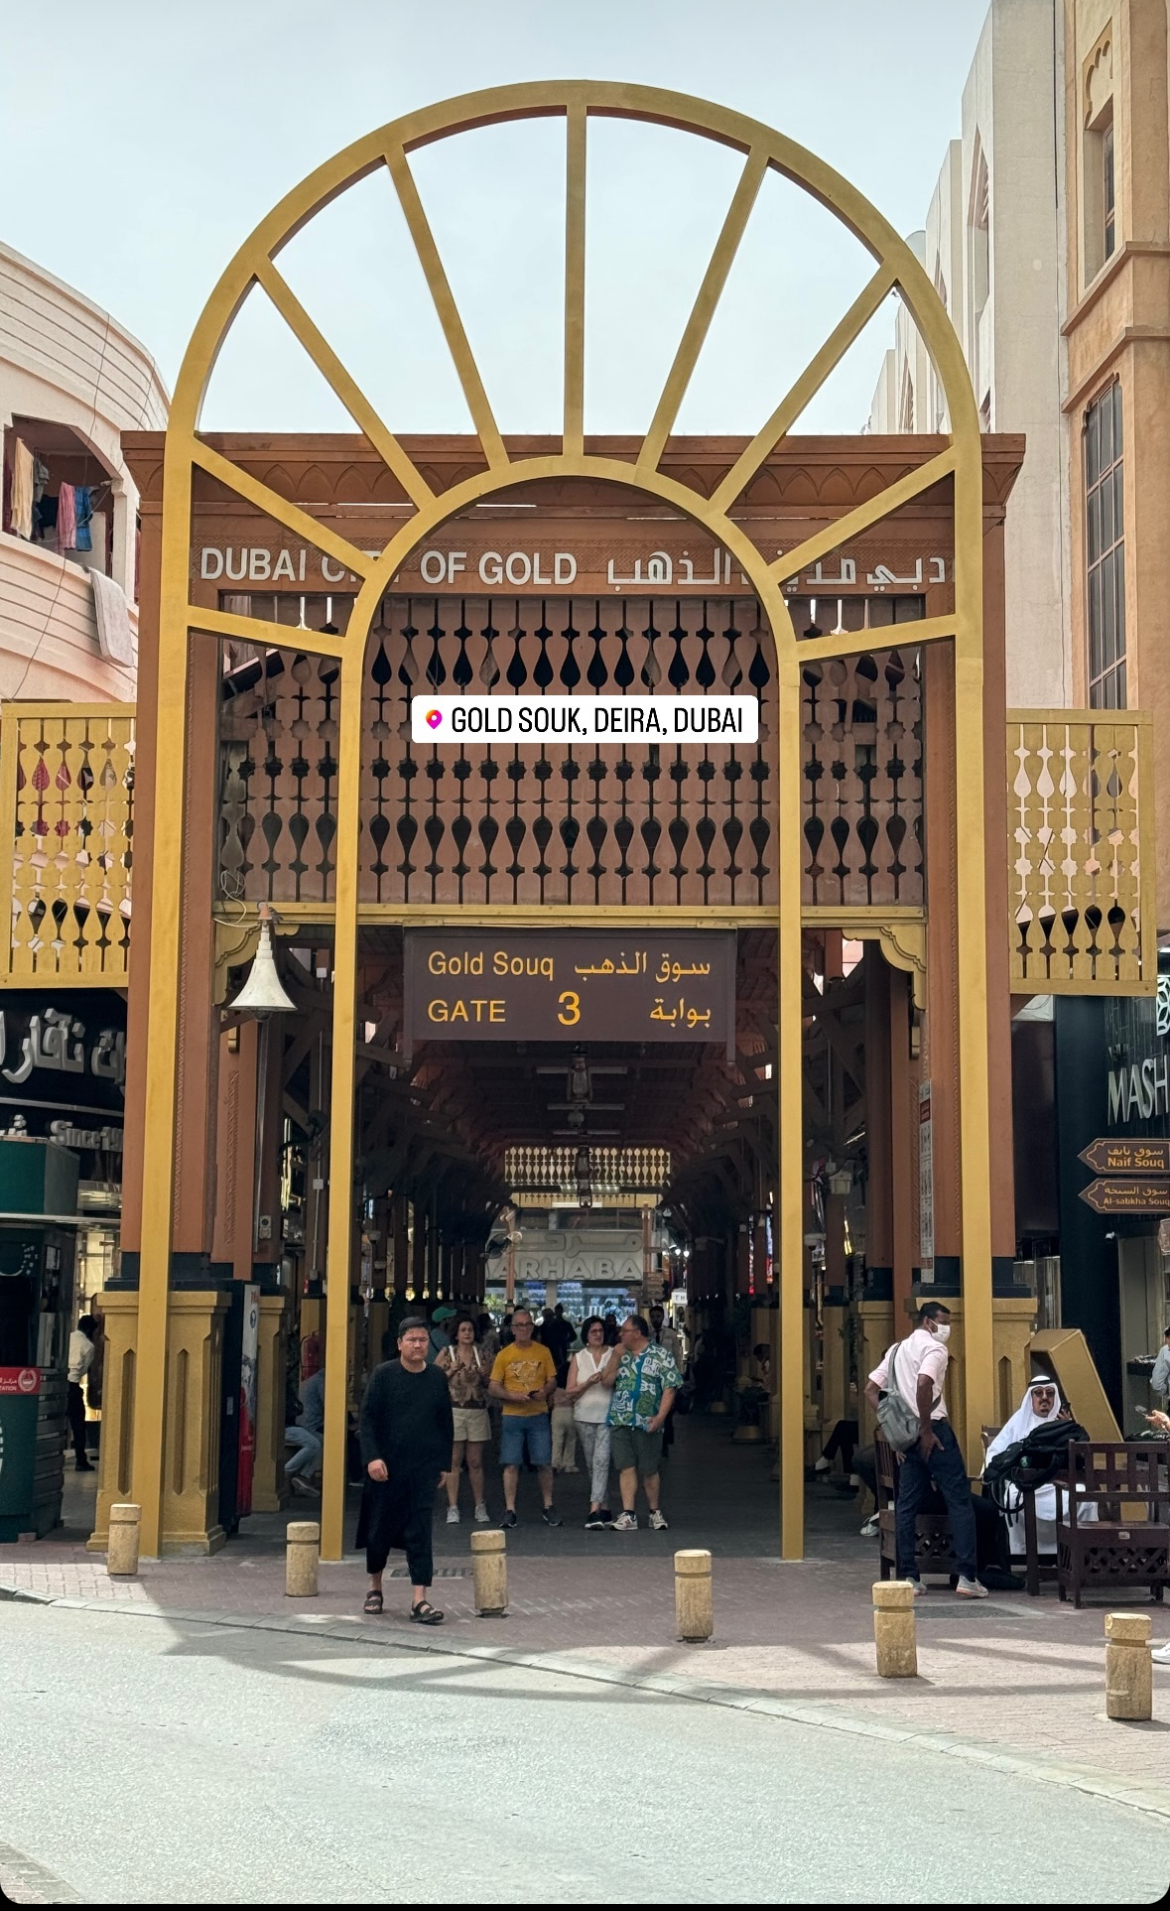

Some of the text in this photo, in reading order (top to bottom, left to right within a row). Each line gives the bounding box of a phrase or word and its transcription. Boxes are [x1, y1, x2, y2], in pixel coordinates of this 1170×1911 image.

[200, 547, 306, 582] DUBAI
[420, 550, 467, 584] OF
[478, 551, 577, 585] GOLD
[607, 547, 731, 592] الذهب
[866, 557, 946, 592] دبي
[427, 951, 554, 981] Gold Souq
[574, 951, 711, 983] سوق الذهب
[427, 991, 581, 1026] GATE 3
[649, 998, 711, 1028] بوابة
[49, 1120, 100, 1150] Since
[1107, 1156, 1165, 1170] Naif Souq
[486, 1257, 644, 1281] ARHABA
